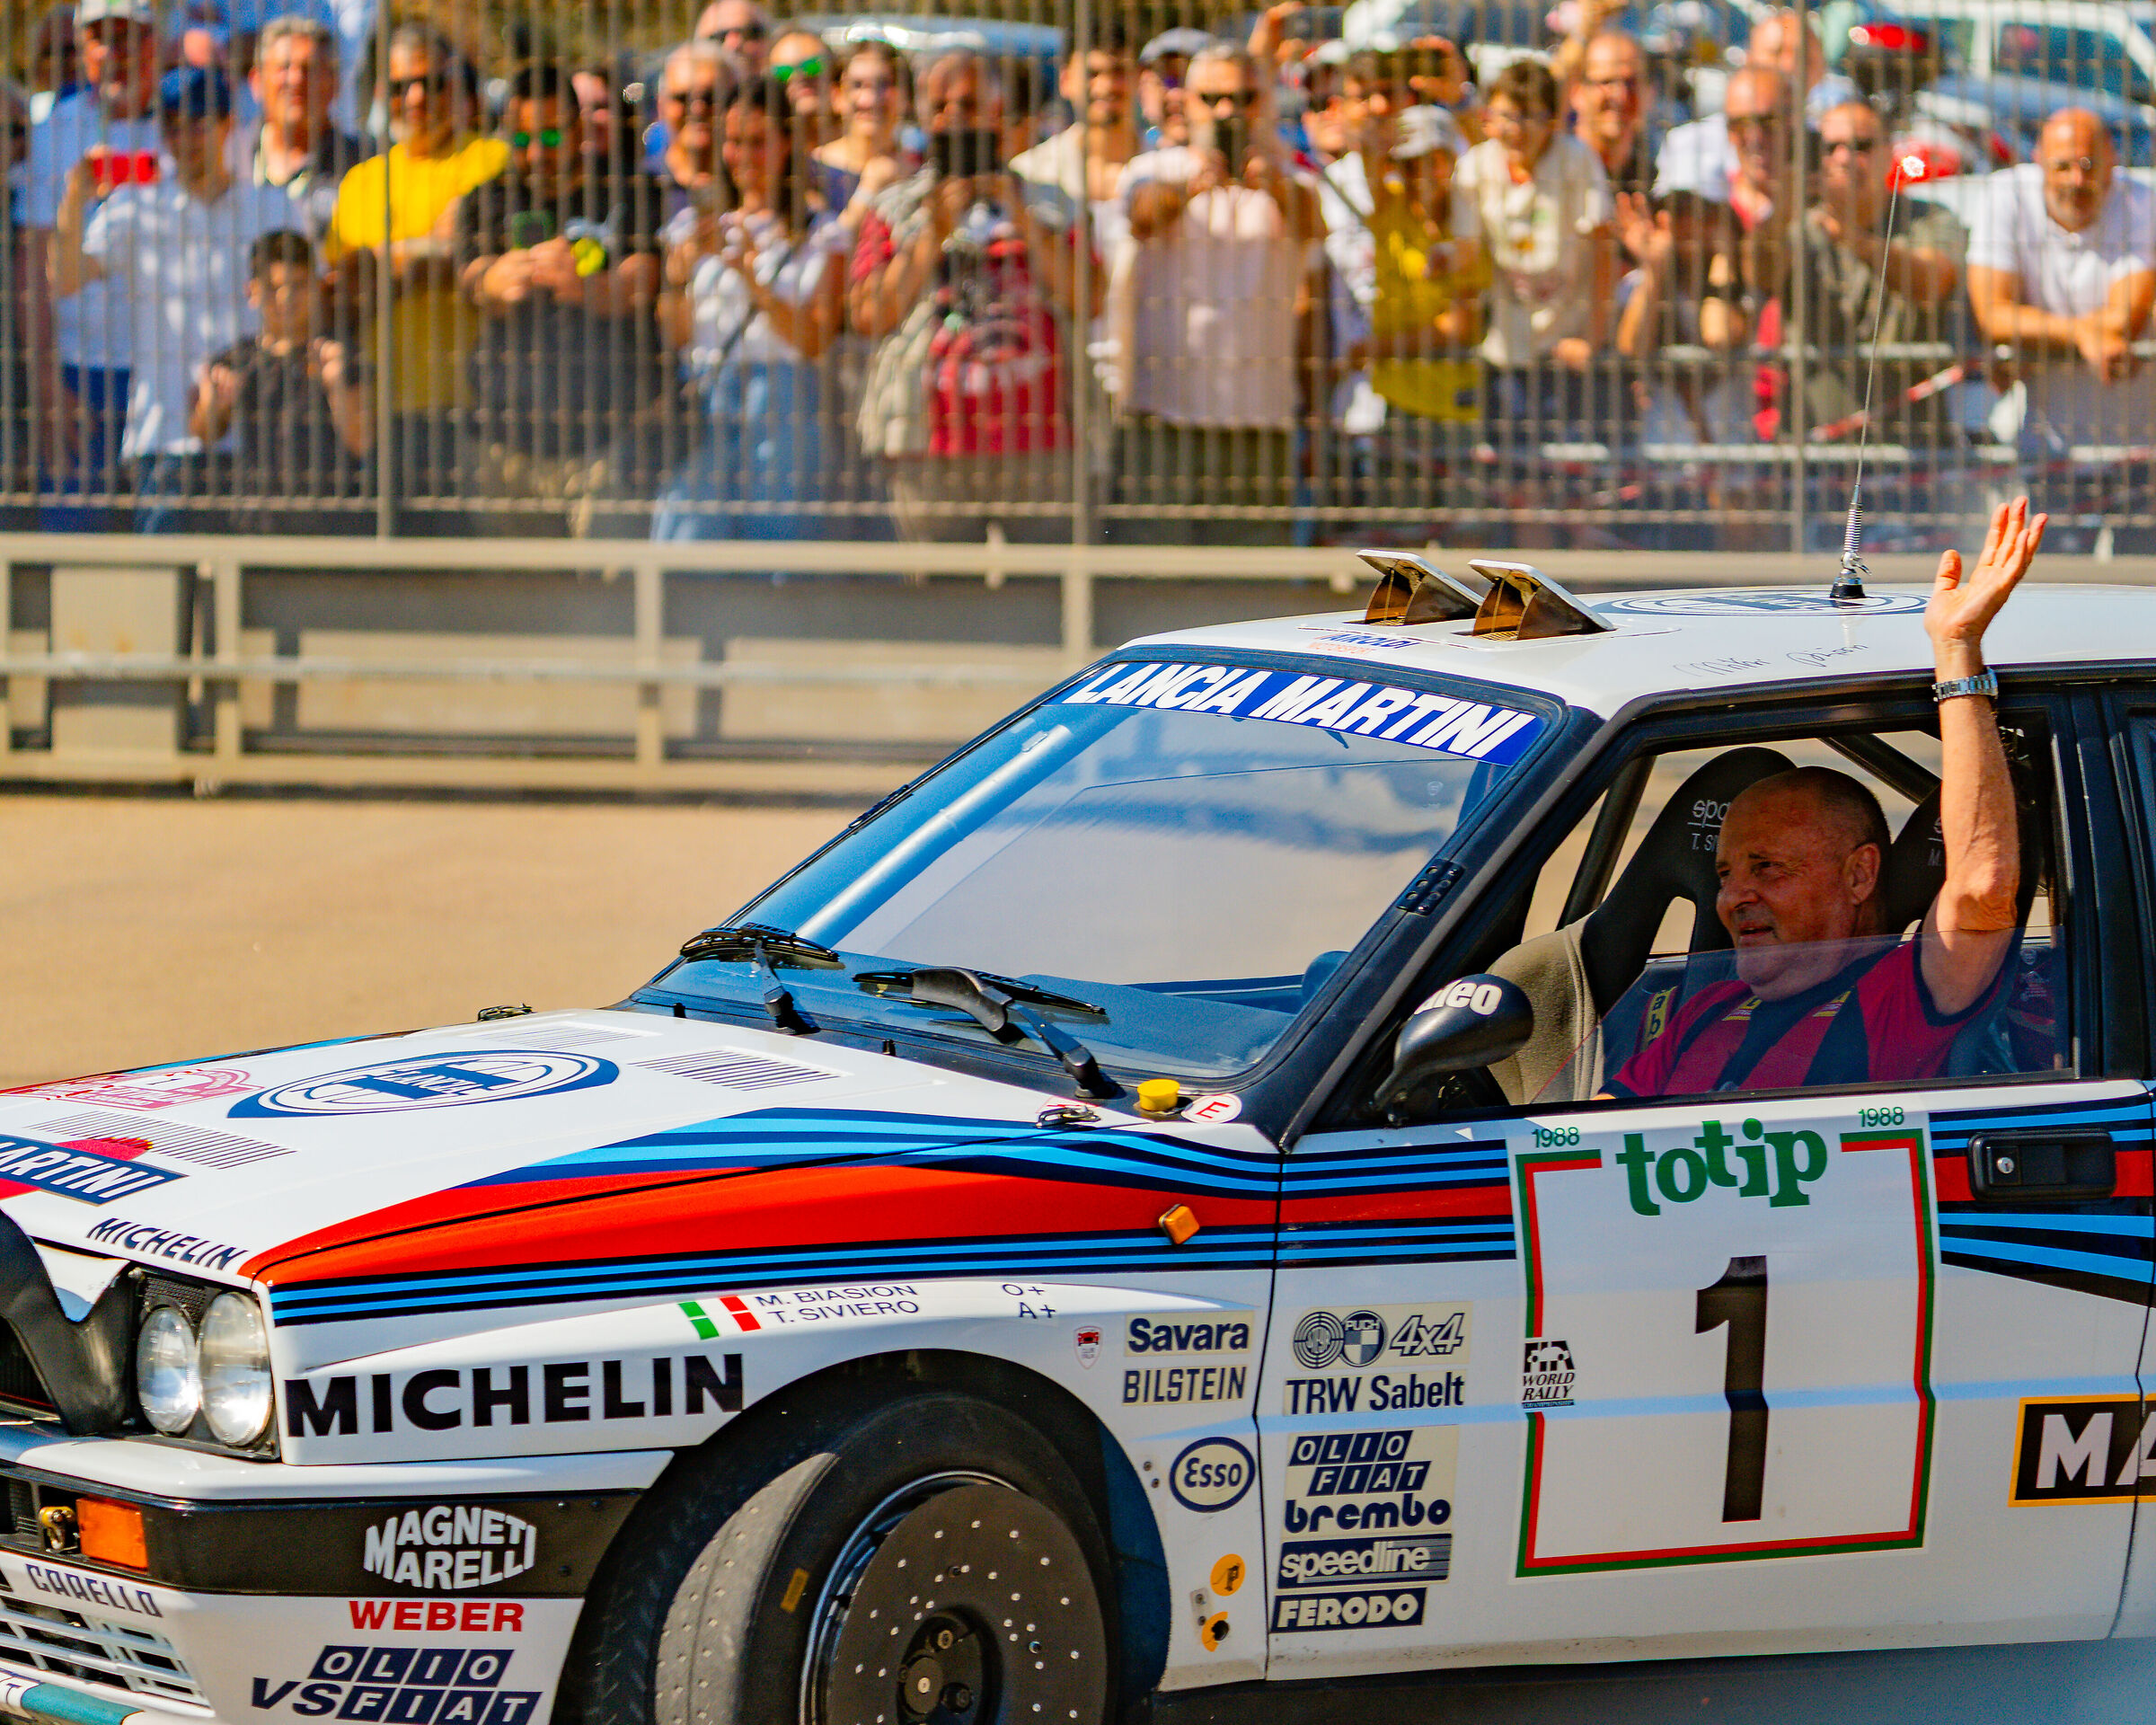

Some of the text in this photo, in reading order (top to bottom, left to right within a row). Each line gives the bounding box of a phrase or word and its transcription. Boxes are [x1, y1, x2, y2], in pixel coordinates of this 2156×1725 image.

[1061, 663, 1535, 758] LANCIA MARTINI
[1692, 800, 1731, 828] spa
[1413, 978, 1503, 1016] aleo
[1195, 1101, 1231, 1119] E
[1858, 1106, 1904, 1128] 1988
[1531, 1127, 1581, 1149] 1988
[0, 1142, 165, 1199] ARTINI
[1615, 1118, 1828, 1216] totip
[86, 1217, 250, 1271] MICHELIN
[755, 1284, 919, 1306] M. BIASION
[766, 1300, 920, 1323] T. SIVIERO
[1018, 1302, 1057, 1319] A+
[1128, 1317, 1249, 1353] Savara
[1345, 1320, 1380, 1331] PUCH
[1389, 1313, 1466, 1357] 4x4
[284, 1353, 745, 1438] MICHELIN
[1123, 1367, 1247, 1403] BILSTEIN
[1286, 1371, 1465, 1415] TRW Sabelt
[1523, 1372, 1575, 1386] WORLD
[1523, 1385, 1574, 1401] RALLY
[1694, 1255, 1769, 1523] 1
[1294, 1433, 1408, 1463] OLIO
[1183, 1456, 1242, 1489] Esso
[1313, 1464, 1427, 1494] FIAT
[1285, 1493, 1451, 1534] brembo
[364, 1506, 536, 1569] MAGNETI
[364, 1527, 536, 1589] MARELLI
[1281, 1540, 1431, 1583] speedline
[25, 1563, 164, 1617] CARELLO
[349, 1600, 525, 1632] WEBER
[1277, 1594, 1419, 1628] FERODO
[320, 1650, 501, 1683] OLIO
[252, 1677, 530, 1724] VS FIAT
